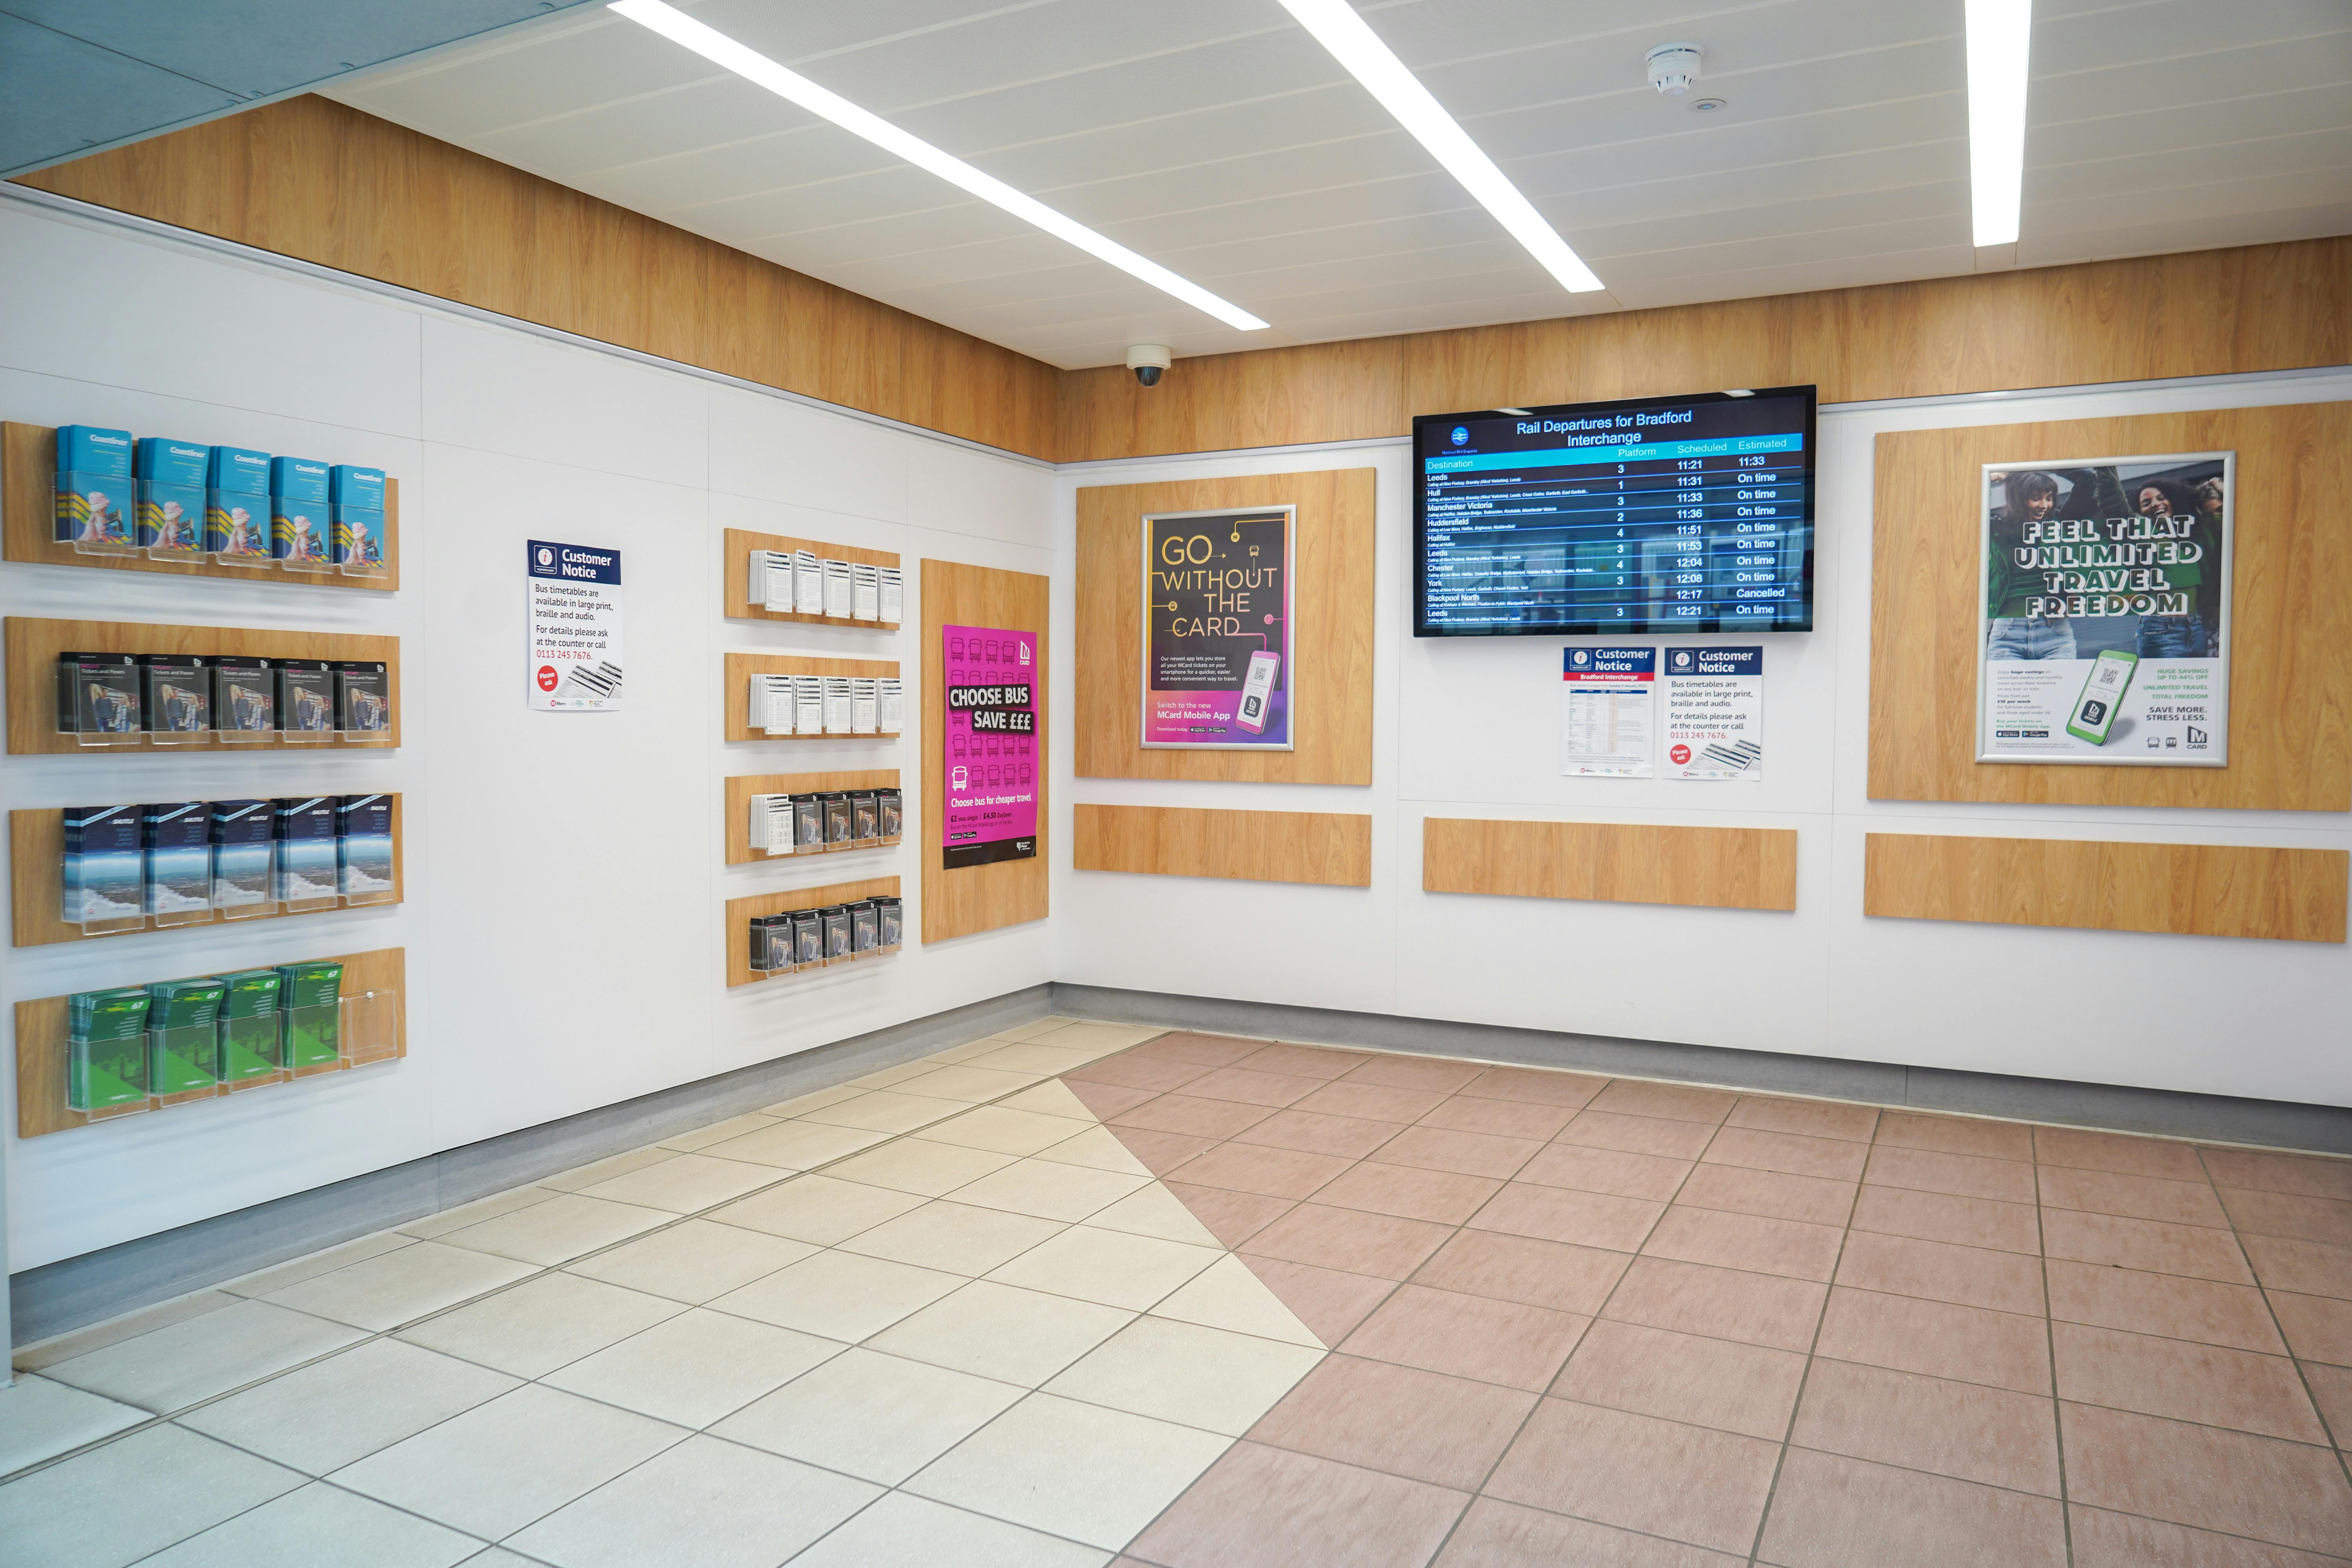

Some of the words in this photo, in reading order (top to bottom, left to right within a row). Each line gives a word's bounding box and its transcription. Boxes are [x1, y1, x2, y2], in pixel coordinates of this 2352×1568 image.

[1517, 422, 1540, 434] Rail
[1544, 418, 1612, 433] Departures
[1615, 415, 1632, 427] for
[1636, 410, 1692, 426] Bradford
[89, 434, 128, 446] Coastliner
[1568, 432, 1641, 446] Interchange
[170, 446, 206, 458] Coastliner
[1428, 460, 1473, 470] Destination
[1619, 448, 1656, 457] Platform
[1677, 443, 1727, 454] Scheduled
[1739, 439, 1786, 450] Estimated
[234, 454, 268, 466] Coastliner
[1618, 465, 1624, 474] 3
[1677, 460, 1702, 470] 11:21
[1739, 456, 1765, 466] 11:33
[1619, 481, 1623, 489] 1
[1677, 476, 1702, 486] 11:31
[1738, 474, 1752, 483] On
[1755, 473, 1776, 481] time
[1427, 503, 1466, 512] Manchester
[1617, 497, 1624, 505] 3
[1677, 492, 1703, 503] 11:33
[1738, 490, 1752, 500] On
[1755, 490, 1776, 498] time
[1427, 518, 1469, 526] Huddersfield
[1617, 513, 1624, 521] 2
[1677, 509, 1702, 519] 11:36
[1737, 507, 1752, 516] On
[1755, 506, 1775, 515] time
[1617, 528, 1624, 537] 4
[1677, 525, 1701, 535] 11:51
[1737, 523, 1752, 532] On
[1754, 523, 1775, 531] time
[2023, 519, 2100, 544] FEEL
[2107, 515, 2195, 540] THAT
[1162, 535, 1212, 565] GO
[1617, 544, 1624, 553] 3
[1677, 541, 1702, 551] 11:53
[1737, 540, 1751, 549] On
[1754, 539, 1775, 548] time
[562, 549, 611, 567] Customer
[1617, 560, 1623, 569] 4
[1677, 558, 1702, 567] 12:04
[1737, 557, 1751, 565] On
[1754, 556, 1775, 564] time
[2014, 541, 2202, 570] UNLIMITED
[562, 563, 596, 579] Notice
[1161, 568, 1277, 590] WITHOUT
[1617, 577, 1624, 585] 3
[1677, 574, 1703, 583] 12:08
[1737, 573, 1751, 581] On
[1754, 572, 1775, 581] time
[2043, 568, 2171, 594] TRAVEL
[535, 584, 548, 593] Bus
[550, 586, 587, 596] timetables
[1428, 595, 1459, 603] Blackpool
[1676, 590, 1702, 599] 12:17
[1737, 588, 1784, 598] Cancelled
[536, 598, 568, 607] available
[579, 600, 594, 610] large
[596, 603, 613, 611] print,
[1204, 593, 1250, 613] THE
[1617, 608, 1624, 616] 3
[1676, 606, 1701, 615] 12:21
[1737, 605, 1751, 614] On
[1753, 604, 1774, 613] time
[2025, 593, 2188, 619] FREEDOM
[536, 609, 558, 618] braille
[575, 612, 595, 621] audio.
[537, 625, 548, 633] For
[549, 626, 573, 635] details
[575, 628, 596, 638] please
[598, 628, 608, 637] ask
[1172, 617, 1240, 637] CARD
[545, 638, 557, 646] the
[595, 641, 606, 649] call
[537, 650, 555, 658] 0113
[573, 651, 592, 660] 7676.
[1595, 650, 1649, 659] Customer
[1699, 651, 1753, 661] Customer
[1595, 661, 1632, 671] Notice
[1699, 662, 1735, 673] Notice
[950, 688, 1001, 706] CHOOSE
[1005, 687, 1028, 704] BUS
[974, 711, 1006, 729] SAVE
[1010, 714, 1031, 730] £££
[1213, 711, 1230, 721] App
[951, 797, 974, 808] Choose
[975, 797, 985, 806] bus
[986, 796, 995, 805] for
[996, 795, 1016, 806] cheaper
[1017, 793, 1031, 802] travel
[263, 980, 276, 989] 67
[206, 991, 219, 1000] 67
